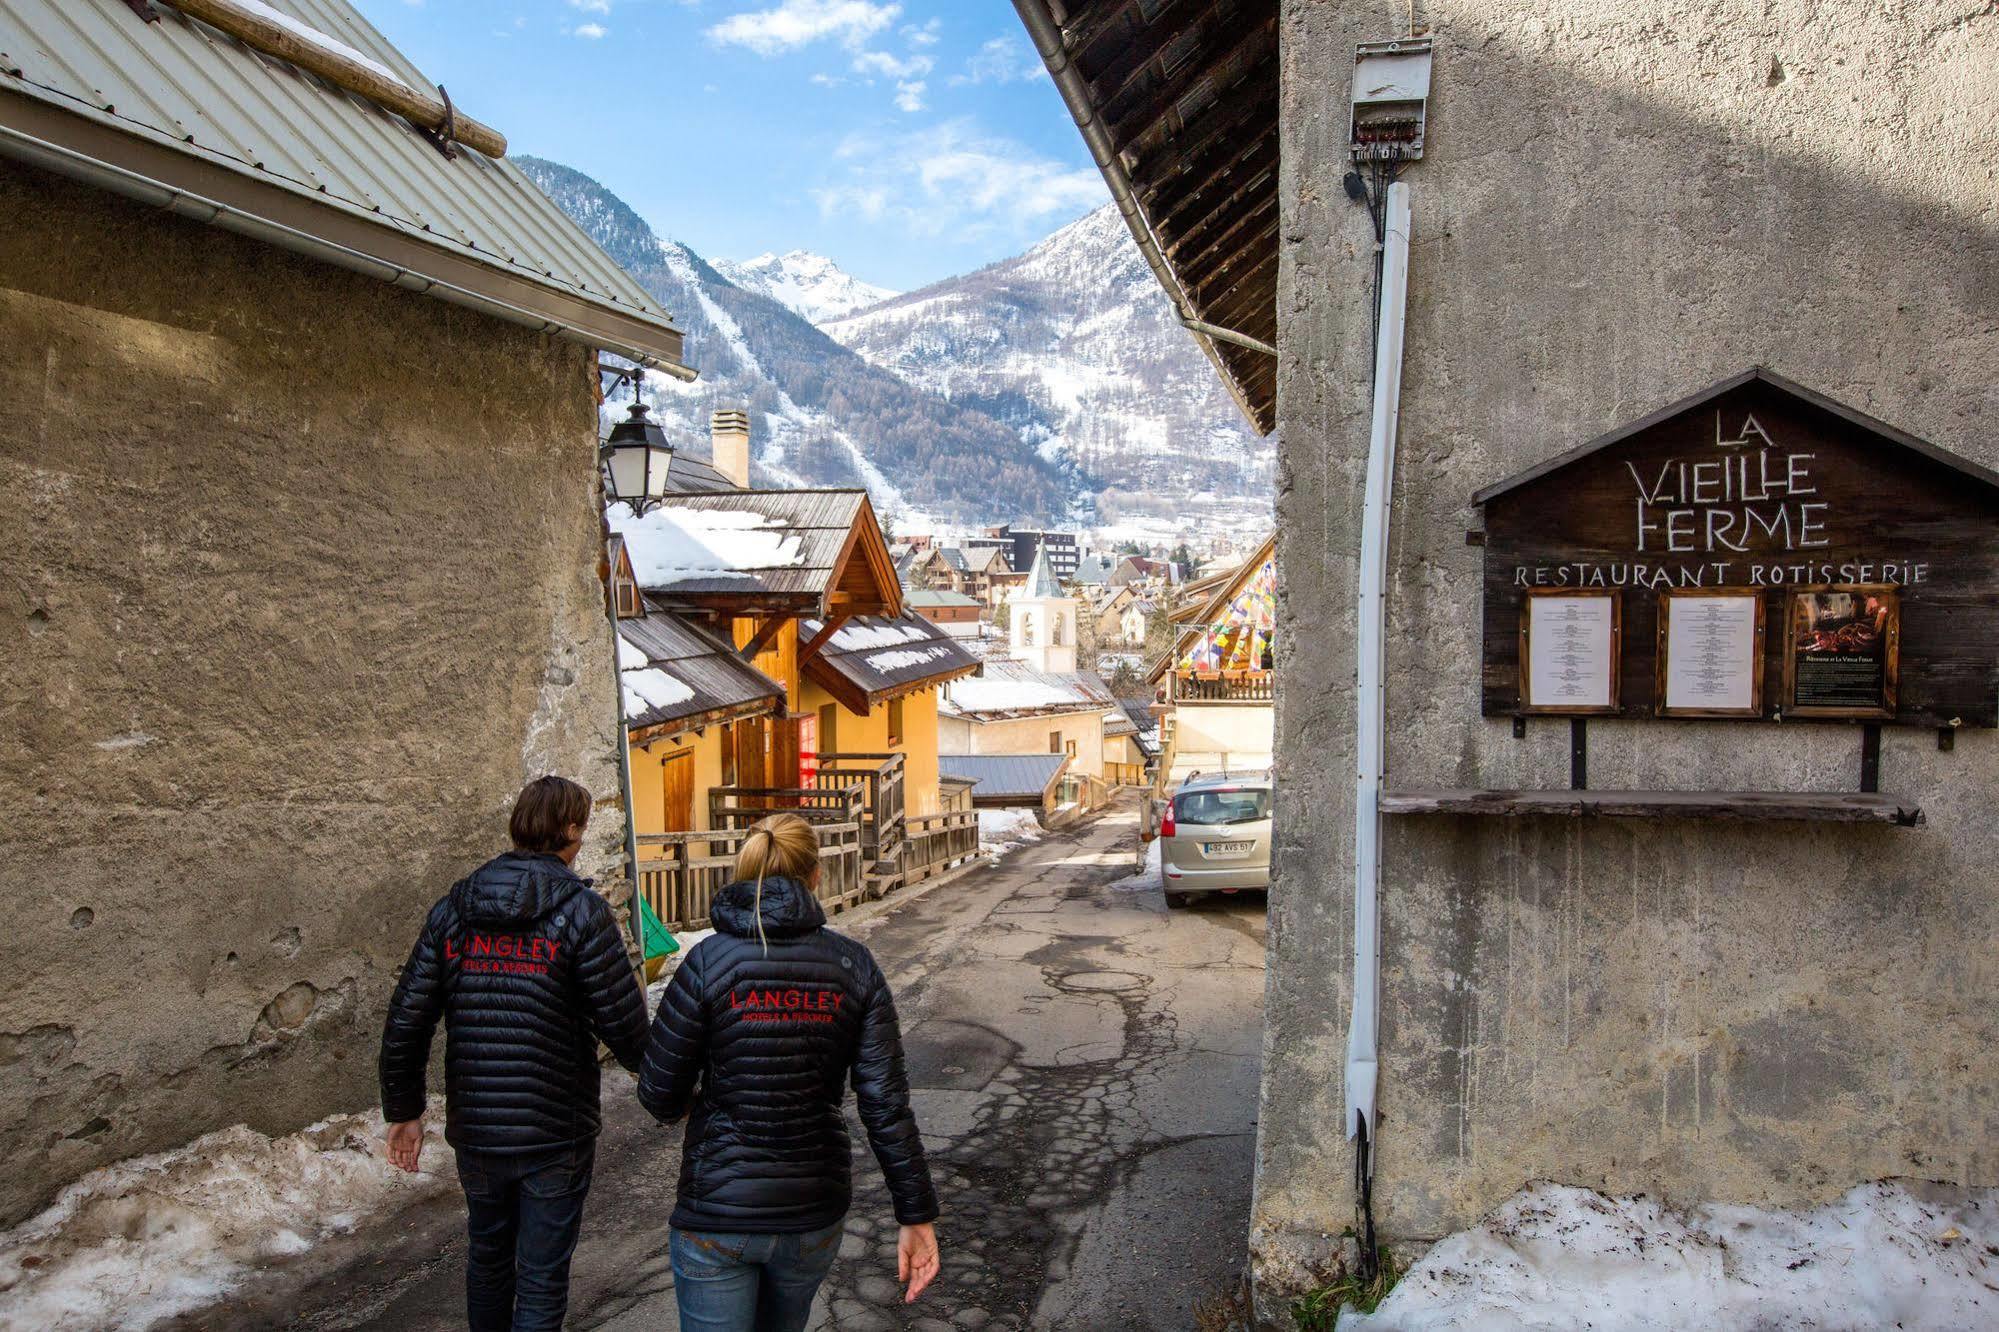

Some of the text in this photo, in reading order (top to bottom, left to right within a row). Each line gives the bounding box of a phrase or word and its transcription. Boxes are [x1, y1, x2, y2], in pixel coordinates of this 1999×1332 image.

[1716, 409, 1776, 447] LA
[1624, 447, 1817, 505] VIEILLE
[1636, 497, 1830, 552] FERME
[1513, 561, 1731, 591] RESTAURANT
[731, 990, 844, 1009] LANGLEY
[742, 1012, 780, 1022] HOTELS
